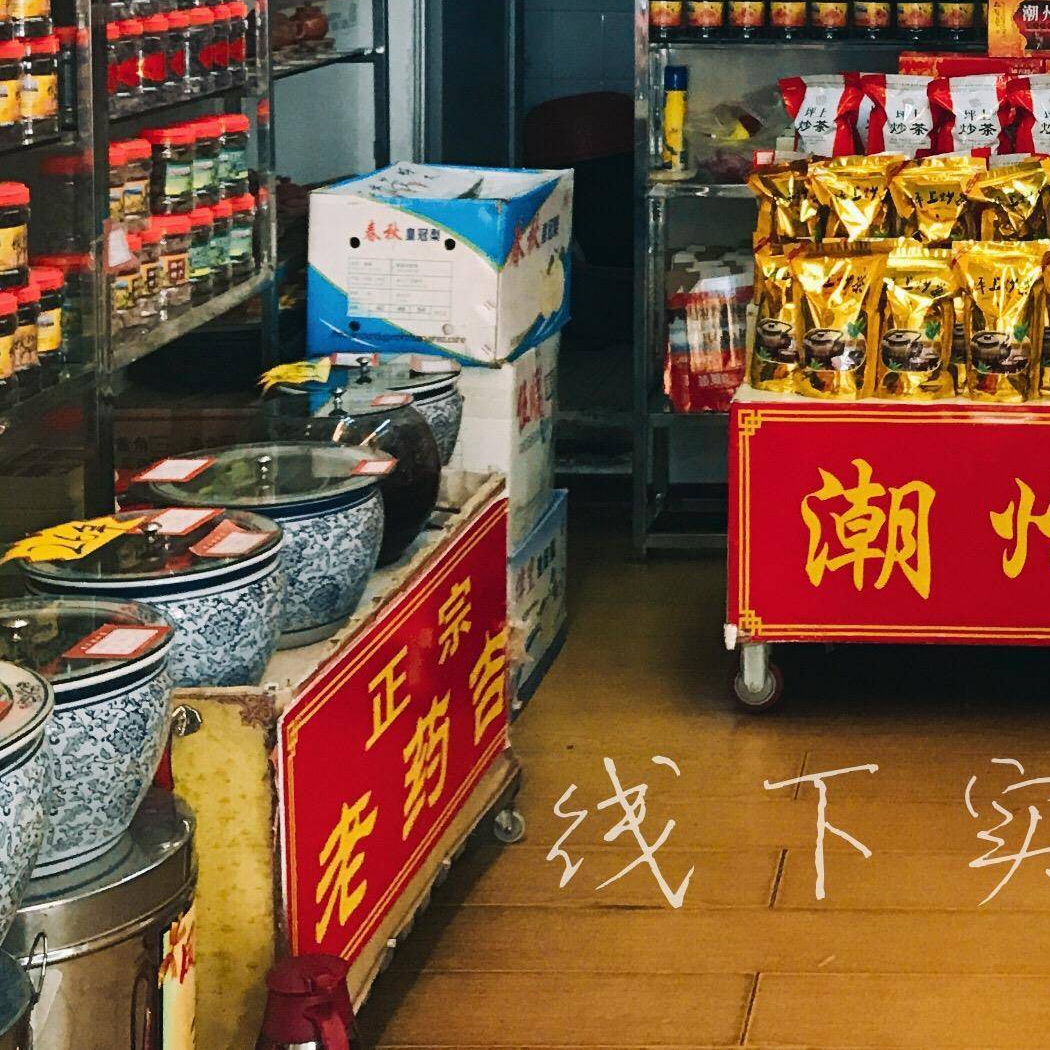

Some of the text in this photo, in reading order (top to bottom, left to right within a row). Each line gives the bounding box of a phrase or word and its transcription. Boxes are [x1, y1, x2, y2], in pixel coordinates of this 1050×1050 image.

[798, 120, 830, 133] 炒茶
[889, 122, 929, 136] 炒茶
[958, 123, 997, 136] 炒茶
[365, 575, 472, 751] 正宗
